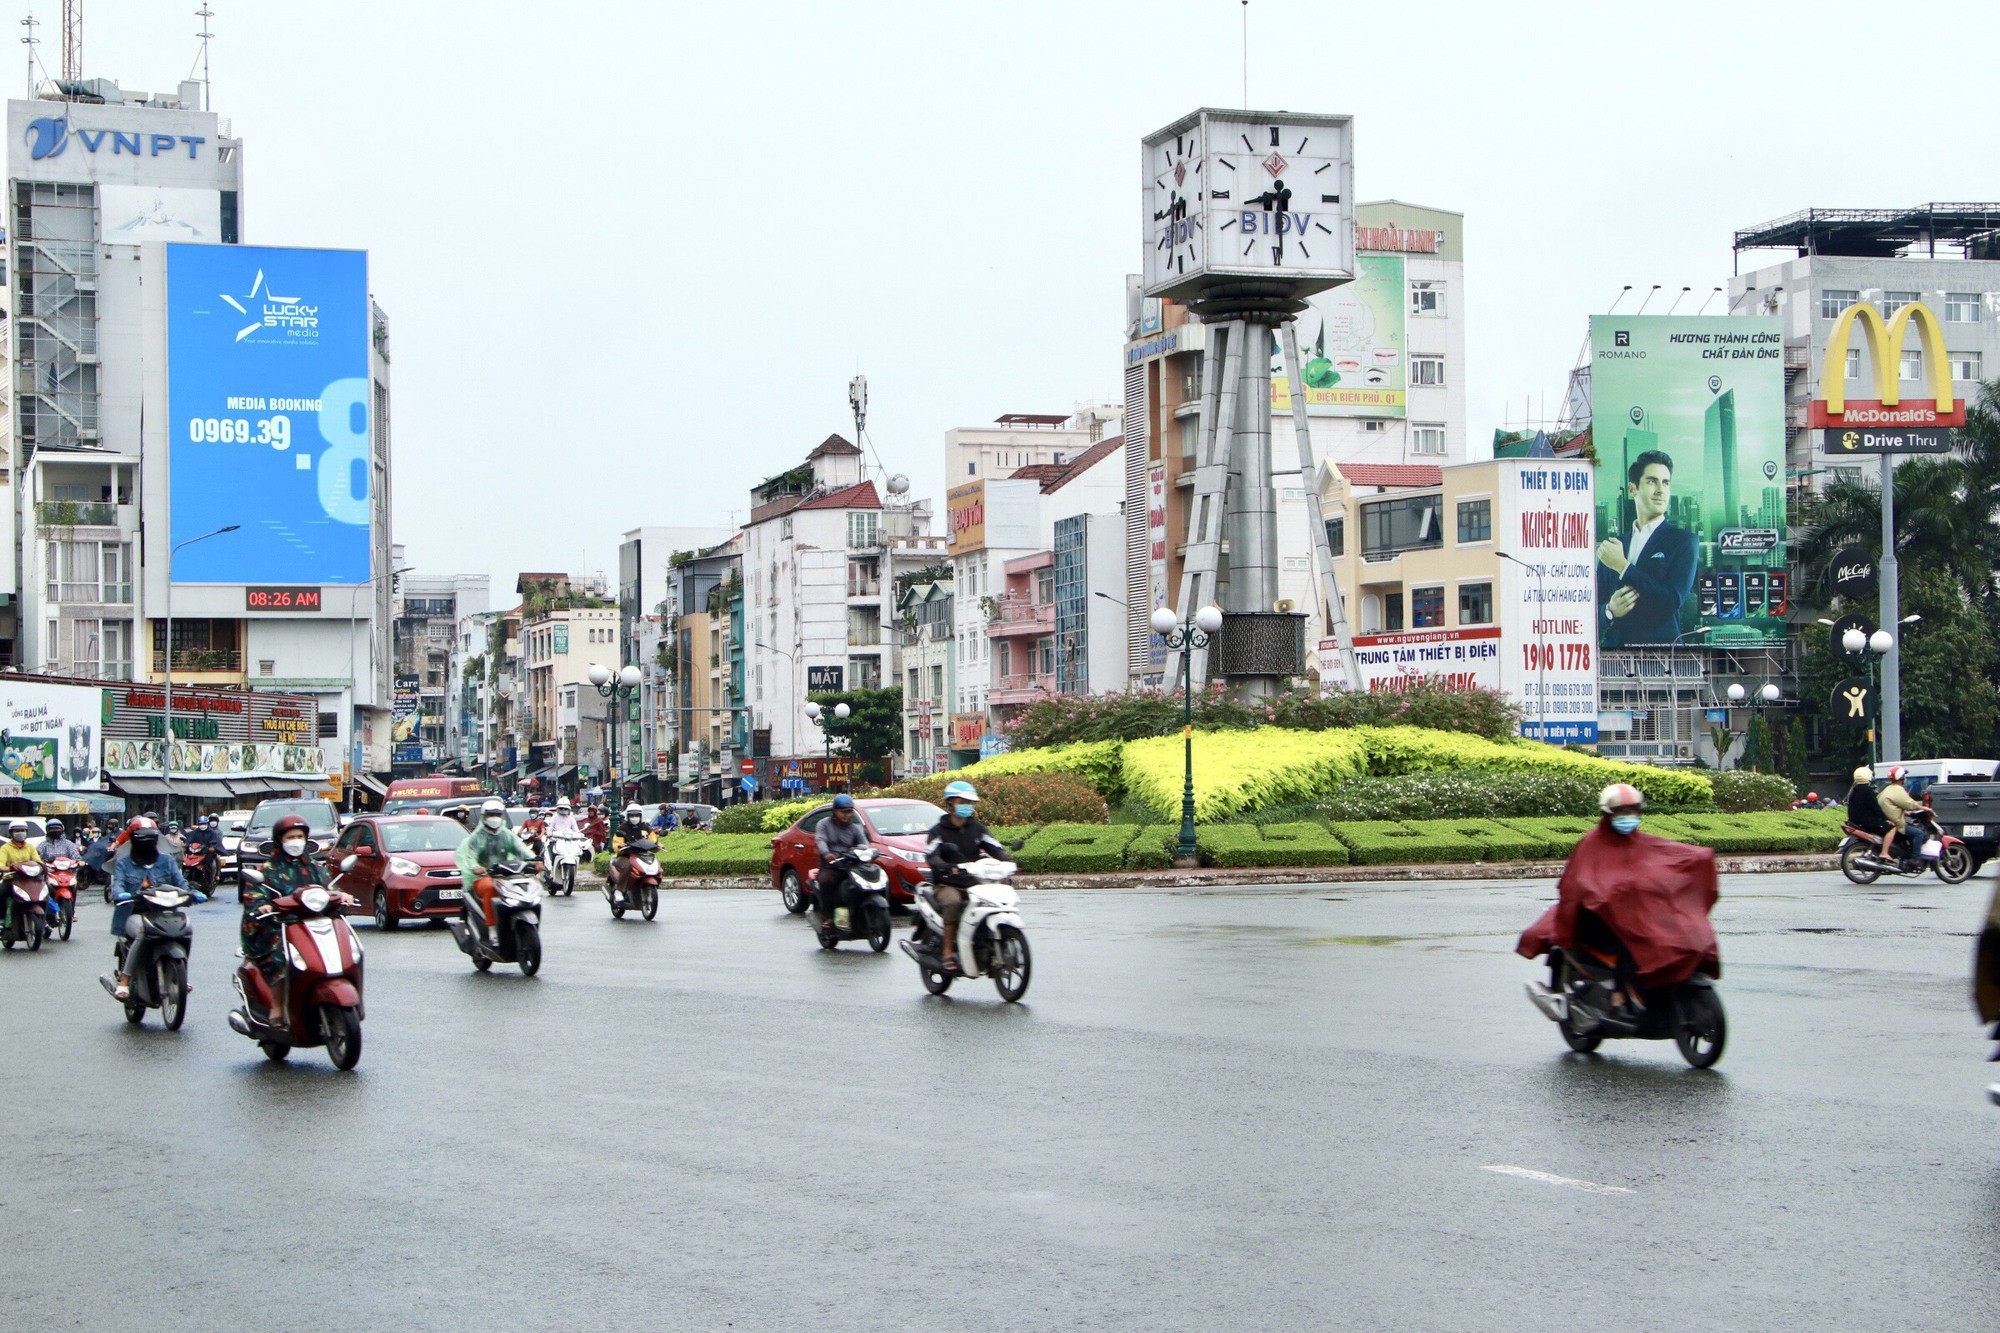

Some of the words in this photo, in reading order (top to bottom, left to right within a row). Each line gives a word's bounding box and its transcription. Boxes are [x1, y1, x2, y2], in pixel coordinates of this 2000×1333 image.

[78, 129, 206, 159] VNPT
[1240, 210, 1311, 236] BIDV
[1407, 229, 1436, 253] ANH
[263, 304, 318, 316] LUCKY
[263, 316, 318, 328] STAR
[287, 328, 319, 337] media
[1713, 331, 1749, 344] THÀNH
[1751, 331, 1780, 344] CÔNG
[1599, 350, 1647, 359] ROMANO
[1757, 345, 1780, 359] ÔNG
[227, 397, 266, 410] MEDIA
[269, 398, 323, 412] BOOKING
[1385, 394, 1396, 403] Q1
[1844, 409, 1936, 423] McDonald's
[190, 415, 291, 451] 0969.39
[1864, 433, 1903, 447] Drive
[1907, 434, 1938, 447] Thru
[1521, 465, 1548, 490] THIẾT
[1562, 512, 1589, 549] GIANG
[1722, 534, 1742, 547] X2
[1837, 563, 1872, 581] McCafé
[249, 592, 291, 606] 08:26
[295, 592, 318, 606] AM
[1532, 619, 1583, 635] HOTLINE:
[1376, 631, 1460, 645] www.nguyengiang.vn
[1355, 651, 1389, 665] TRUNG
[1393, 646, 1416, 663] TÂM
[1419, 642, 1451, 661] THIẾT
[1455, 645, 1466, 662] BỊ
[1469, 641, 1497, 661] ĐIỆN
[1523, 643, 1555, 671] 1900
[1559, 643, 1591, 671] 1778
[811, 666, 839, 685] MẮT
[1525, 683, 1551, 696] ĐT-ZLO:
[24, 708, 37, 720] RAU
[1534, 727, 1549, 737] ĐIN
